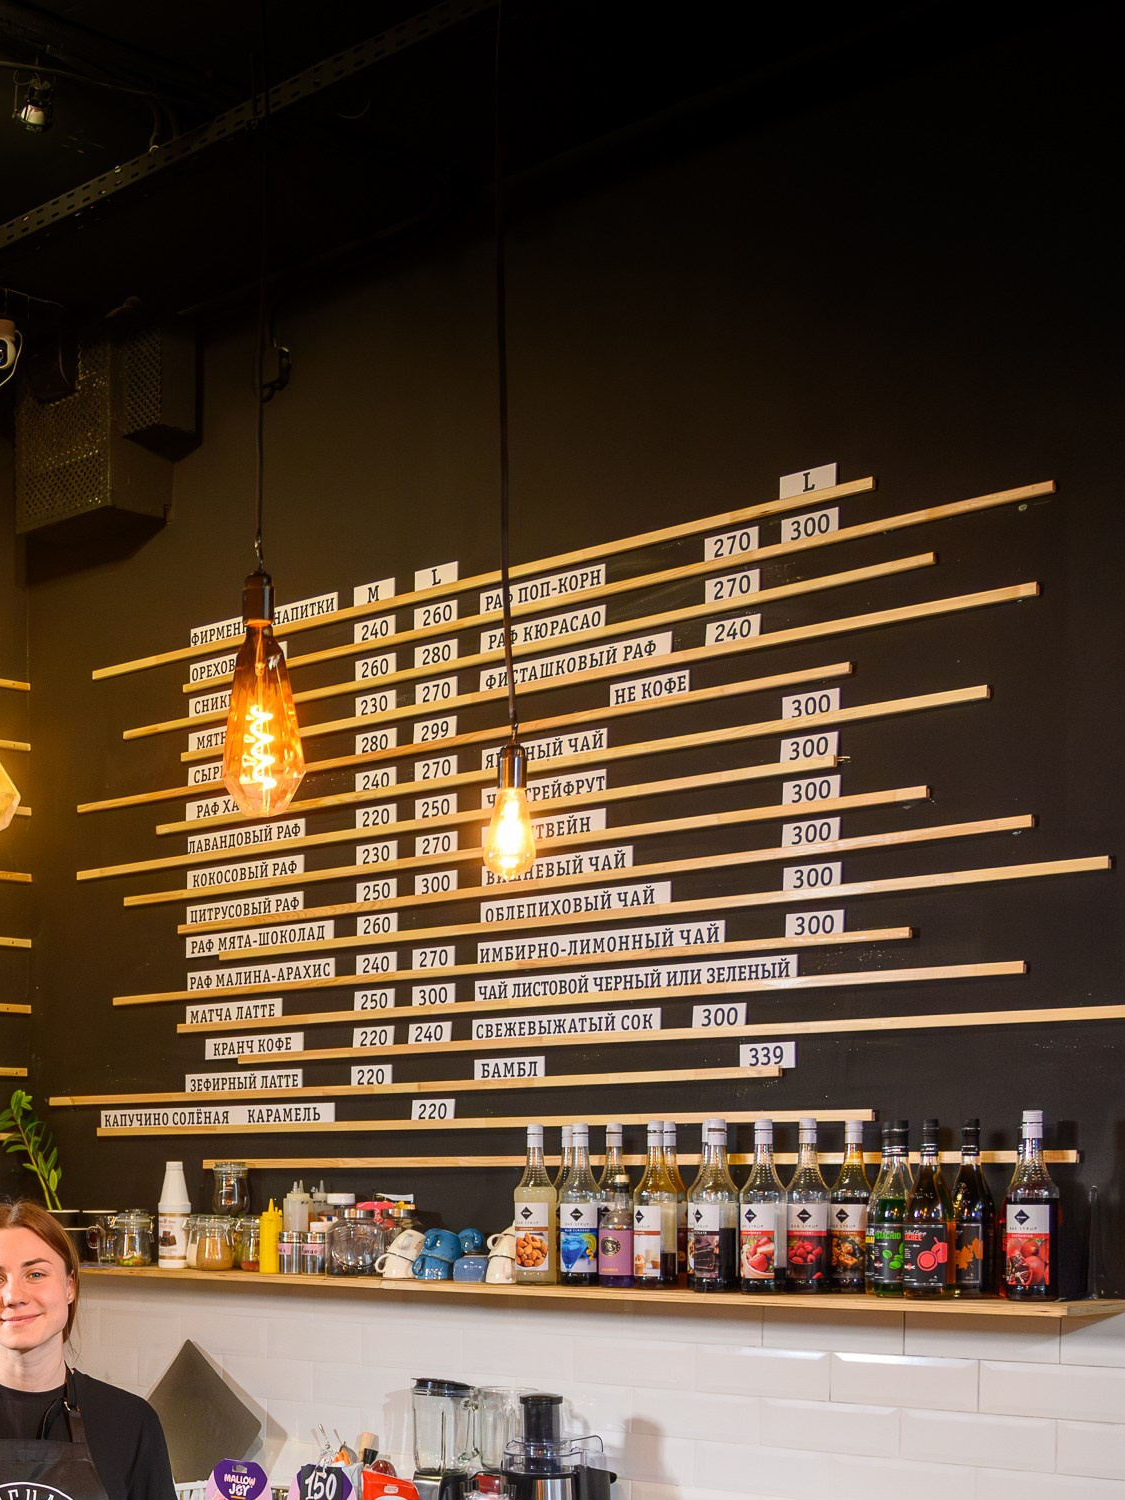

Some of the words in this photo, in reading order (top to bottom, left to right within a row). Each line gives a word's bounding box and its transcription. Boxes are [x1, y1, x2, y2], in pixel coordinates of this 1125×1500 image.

[803, 473, 815, 492] L
[518, 570, 601, 604] ПОП-КОРН
[714, 532, 751, 558] 270
[273, 598, 335, 625] НАПИТКИ
[367, 585, 380, 602] M
[432, 569, 441, 585] L
[488, 630, 517, 649] РАФ
[523, 611, 601, 644] КЮРАСАО
[714, 575, 751, 600] 270
[485, 646, 617, 689] ФИСТАШКОВЫЙ
[624, 640, 656, 661] РАФ
[715, 619, 752, 643] 240
[614, 688, 636, 704] НЕ
[642, 675, 687, 699] КОФЕ
[568, 732, 603, 754] ЧАЙ
[789, 736, 828, 760] 300
[196, 802, 219, 818] РАФ
[188, 826, 274, 854] ЛАВАНДОВЫЙ
[276, 824, 301, 841] РАФ
[362, 809, 389, 827] 220
[422, 799, 450, 818] 250
[193, 863, 270, 888] КОКОСОВЫЙ
[272, 861, 297, 878] РАФ
[363, 846, 390, 865] 230
[422, 836, 450, 854] 270
[589, 850, 626, 871] ЧАЙ
[191, 899, 272, 925] ЦИТРУСОВЫЙ
[275, 898, 299, 915] РАФ
[363, 883, 390, 902] 250
[421, 876, 450, 894] 300
[486, 890, 612, 922] ОБЛЕПИХОВЫЙ
[617, 888, 655, 910] ЧАЙ
[793, 867, 833, 888] 300
[191, 938, 214, 955] РАФ
[217, 927, 325, 951] МЯТА-ШОКОЛАД
[364, 918, 391, 936] 260
[480, 928, 674, 964] ИМБИРНО-ЛИМОННЫЙ
[680, 924, 719, 947] ЧАЙ
[795, 915, 834, 937] 300
[190, 975, 213, 991] РАФ
[216, 963, 331, 988] МАЛИНА-АРАХИС
[362, 955, 389, 973] 240
[419, 950, 448, 967] 270
[479, 979, 508, 1000] ЧАЙ
[511, 976, 589, 998] ЛИСТОВОЙ
[593, 969, 663, 992] ЧЕРНЫЙ
[666, 967, 702, 987] ИЛИ
[707, 962, 790, 983] ЗЕЛЕНЫЙ
[190, 1008, 233, 1024] МАТЧА
[236, 1004, 275, 1021] ЛАТТЕ
[360, 993, 387, 1010] 250
[419, 988, 448, 1005] 300
[476, 1014, 617, 1039] СВЕЖЕВЫЖАТЫЙ
[621, 1012, 653, 1030] СОК
[702, 1007, 738, 1027] 300
[213, 1039, 254, 1057] КРАНЧ
[258, 1037, 292, 1052] КОФЕ
[360, 1030, 387, 1047] 220
[415, 1025, 443, 1043] 240
[480, 1061, 538, 1079] БАМБЛ
[749, 1047, 784, 1066] 339
[191, 1074, 257, 1092] ЗЕФИРНЫЙ
[261, 1074, 298, 1090] ЛАТТЕ
[358, 1069, 384, 1086] 220
[105, 1112, 169, 1128] КАПУЧИНО
[173, 1109, 229, 1127] СОЛЁНАЯ
[248, 1108, 320, 1124] КАРАМЕЛЬ
[418, 1103, 447, 1120] 220
[224, 1473, 256, 1486] MALLOW
[229, 1484, 251, 1496] JOY
[305, 1472, 337, 1500] 150
